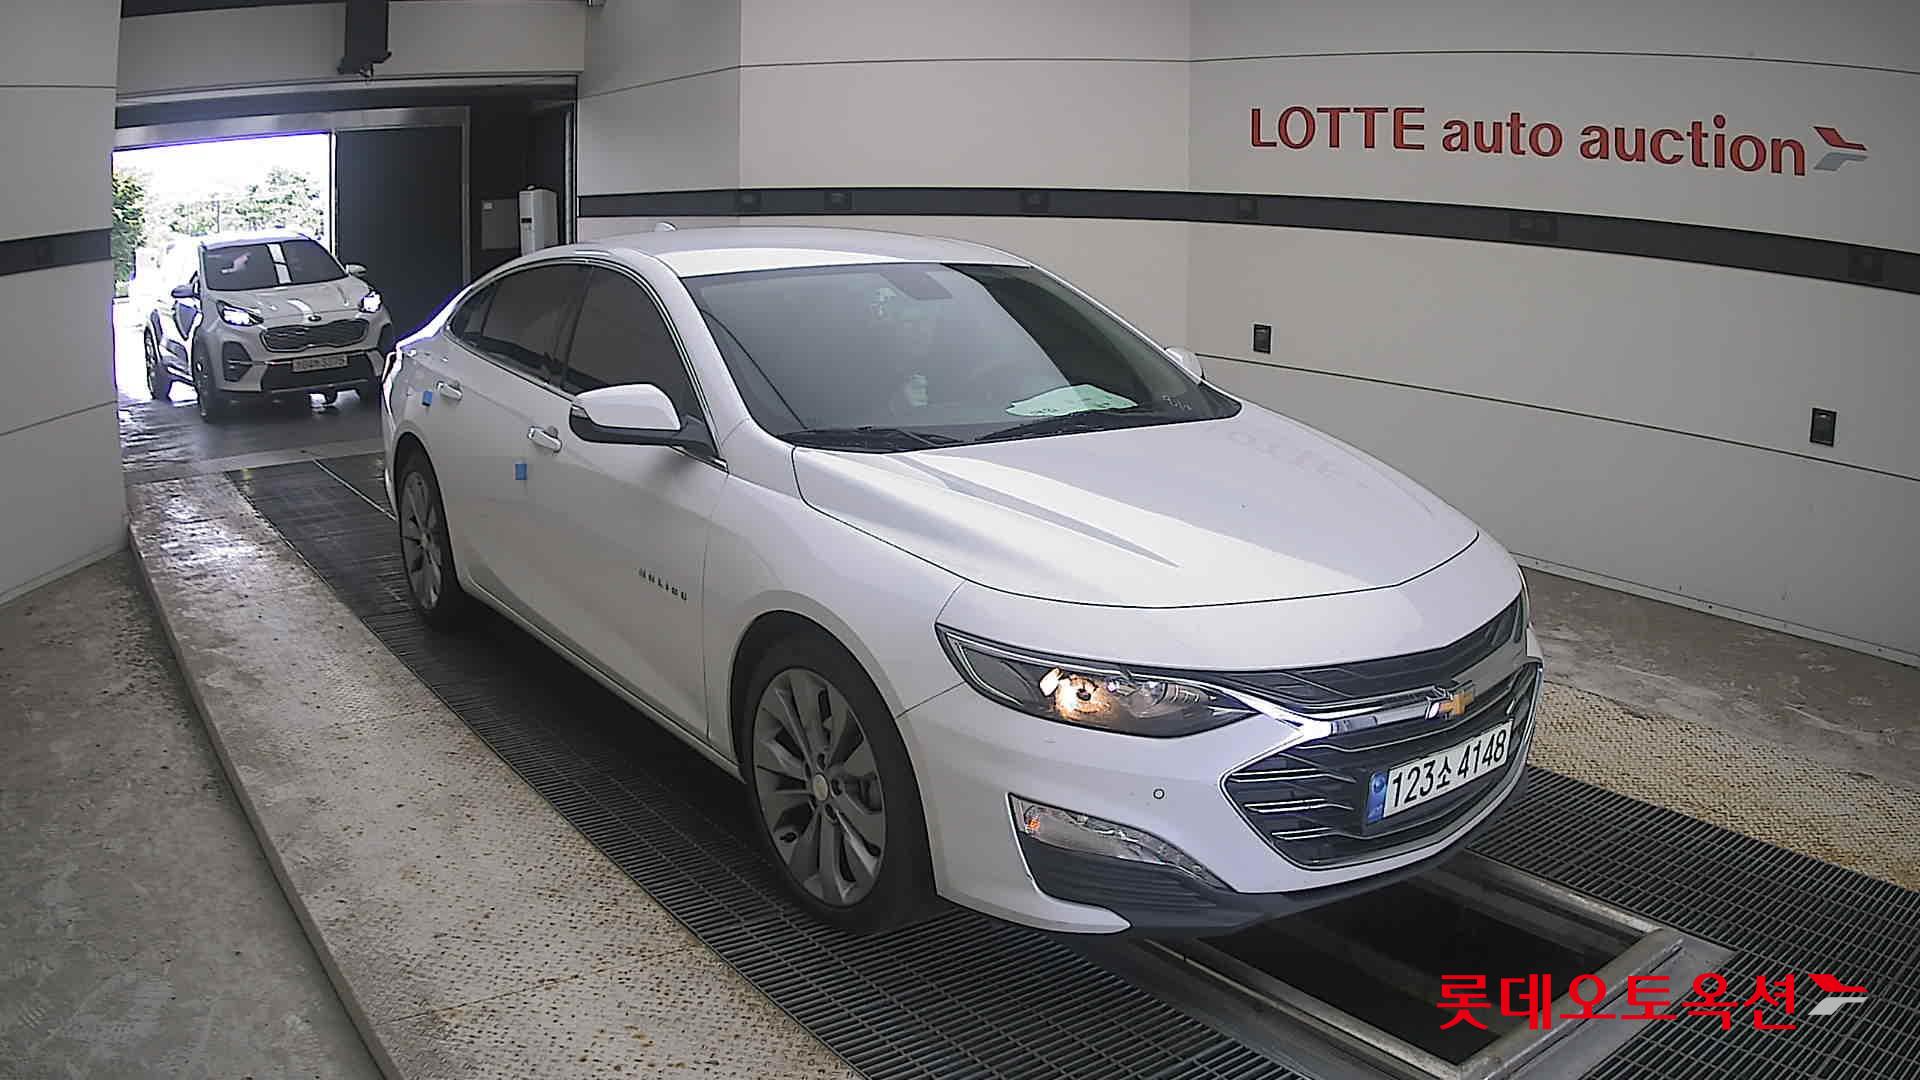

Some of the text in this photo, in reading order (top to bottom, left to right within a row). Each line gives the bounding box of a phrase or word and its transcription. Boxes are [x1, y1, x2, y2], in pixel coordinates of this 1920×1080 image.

[1250, 106, 1807, 177] LOTTE auto auction
